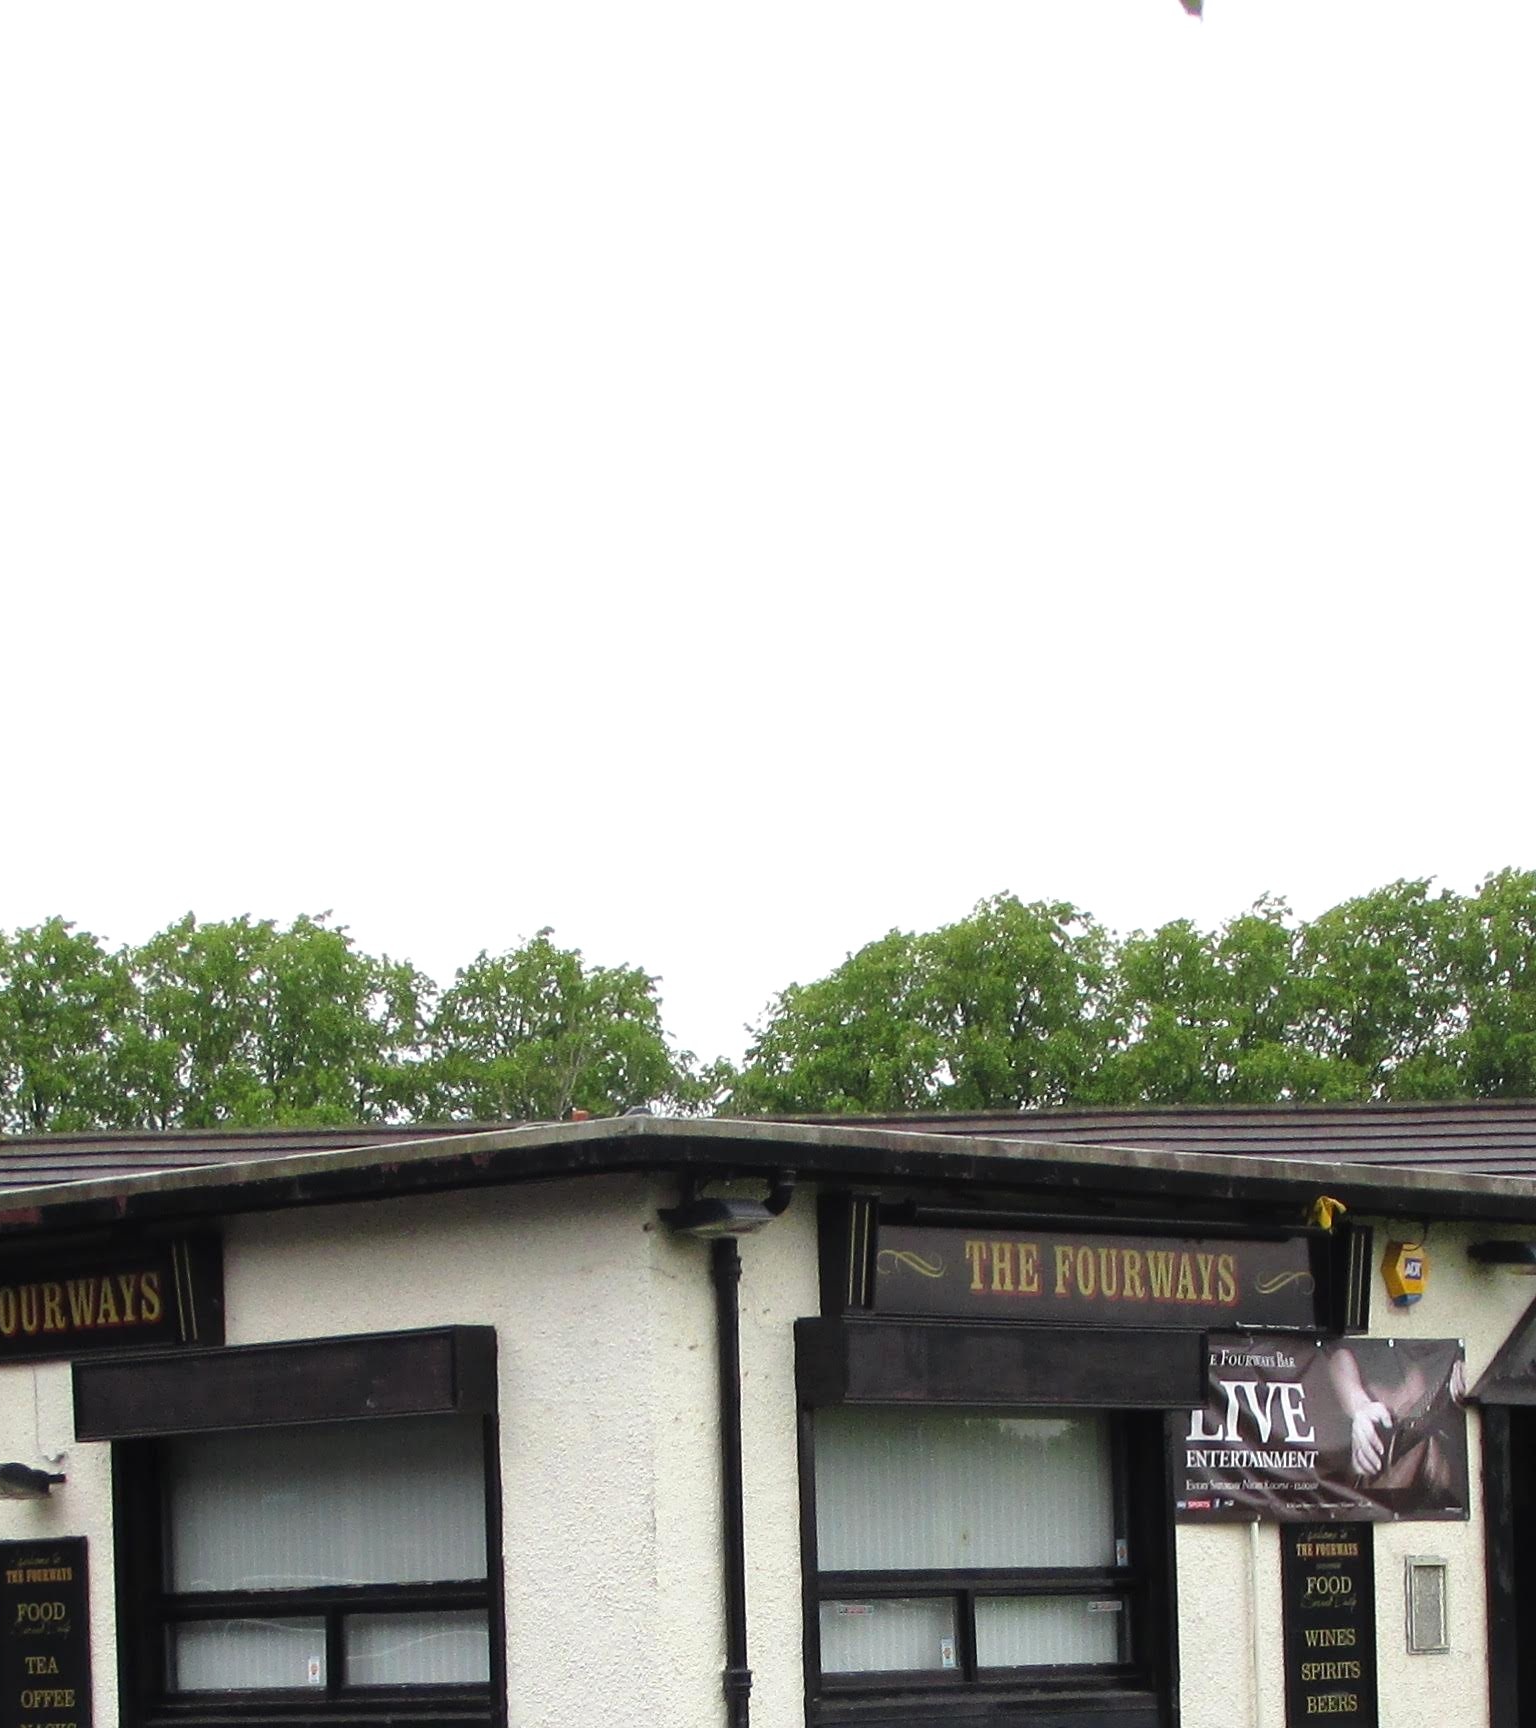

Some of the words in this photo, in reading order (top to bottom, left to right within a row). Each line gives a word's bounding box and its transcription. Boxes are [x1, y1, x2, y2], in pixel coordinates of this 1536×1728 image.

[966, 1240, 1039, 1293] THE
[1054, 1245, 1238, 1304] FOURWAYS
[1185, 1380, 1315, 1443] LIVE
[1186, 1450, 1319, 1468] ENTERTAINMENT
[1296, 1543, 1313, 1556] THE
[1315, 1543, 1358, 1556] FOURWAYS
[26, 1567, 72, 1582] FOURWAYS
[1306, 1576, 1352, 1594] FOOD
[17, 1602, 66, 1622] FOOD
[1305, 1628, 1356, 1648] WINES
[25, 1656, 59, 1675] TEA
[1301, 1661, 1361, 1681] SPIRITS
[21, 1689, 75, 1709] OFFEE
[1307, 1694, 1358, 1714] BEERS
